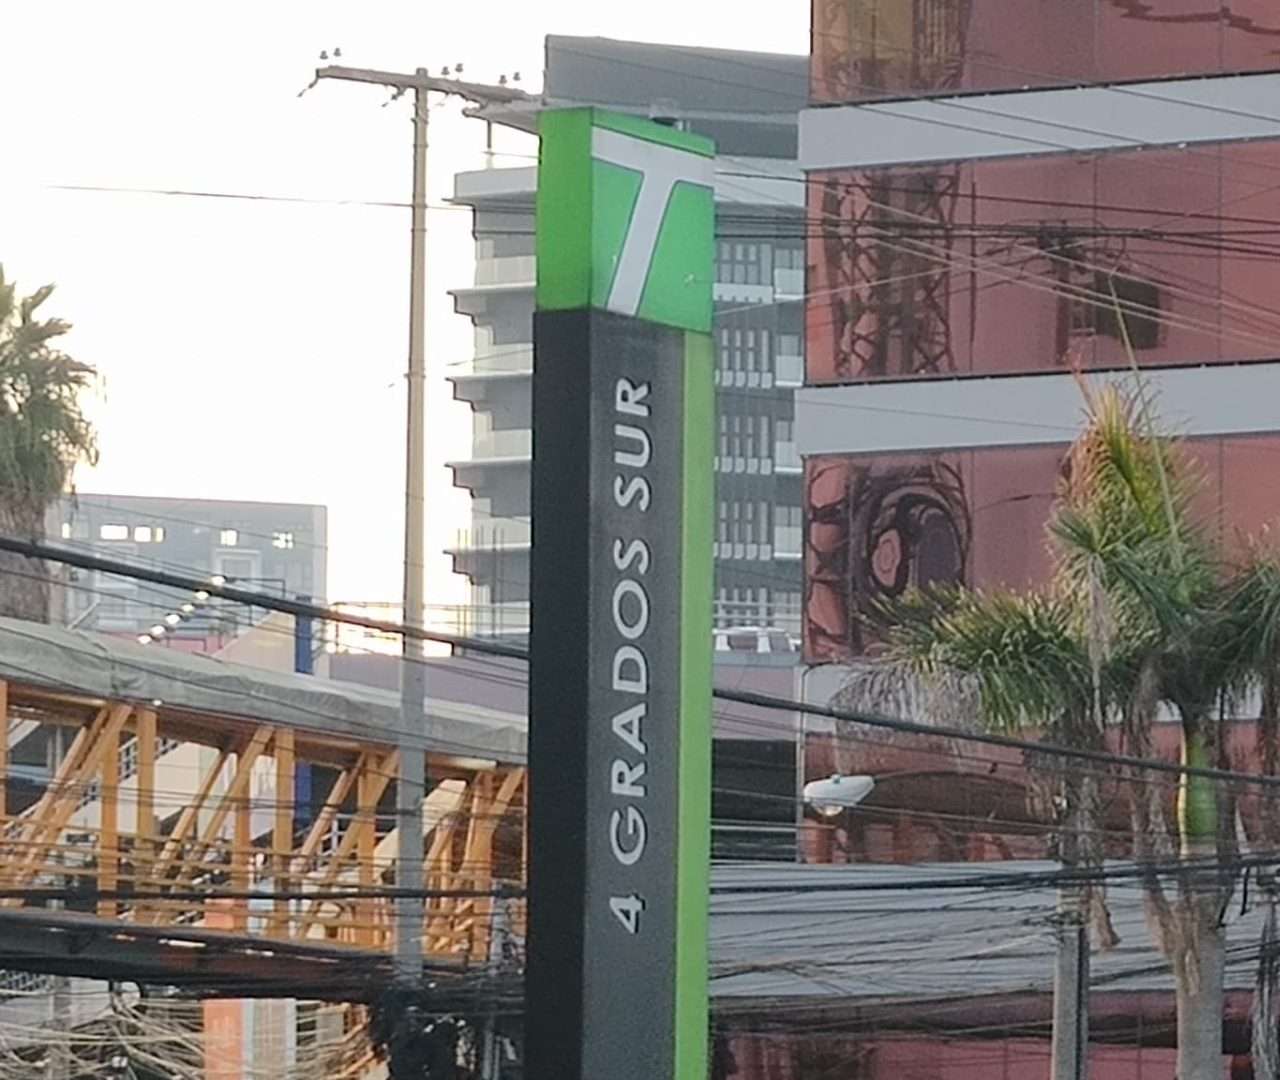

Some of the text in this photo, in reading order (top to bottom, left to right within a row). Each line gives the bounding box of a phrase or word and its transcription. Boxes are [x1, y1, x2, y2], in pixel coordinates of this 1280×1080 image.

[609, 376, 651, 934] 4 GRADOS SUR
